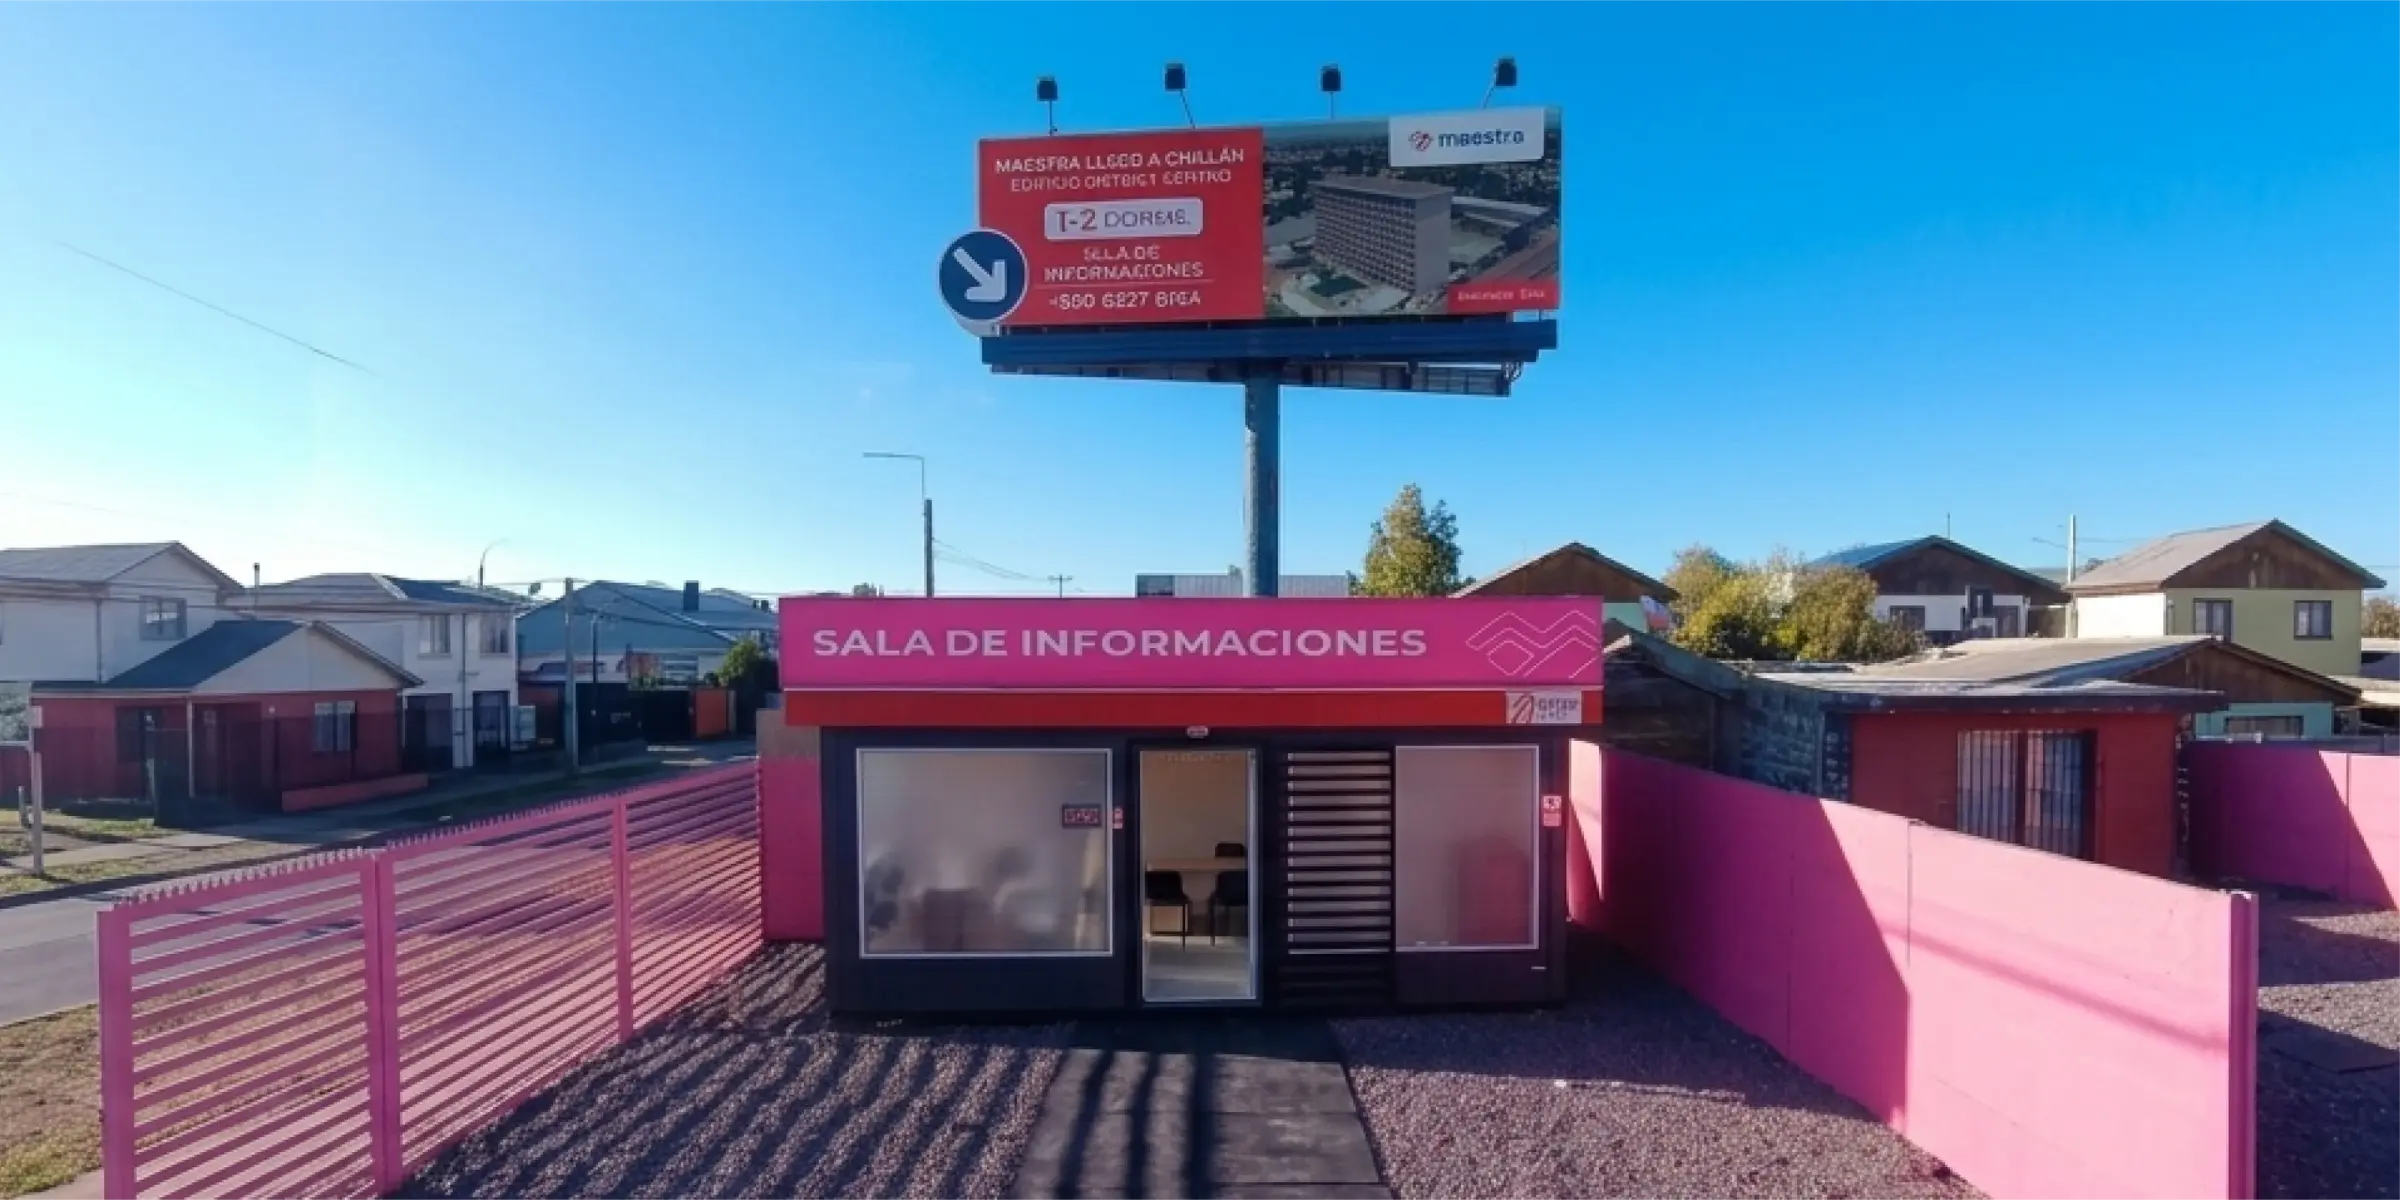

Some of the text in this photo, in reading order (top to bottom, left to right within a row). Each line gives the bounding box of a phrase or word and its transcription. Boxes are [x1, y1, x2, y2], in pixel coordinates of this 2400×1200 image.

[1147, 153, 1161, 167] A
[813, 629, 1427, 656] SALA DE INFORMACIONES
